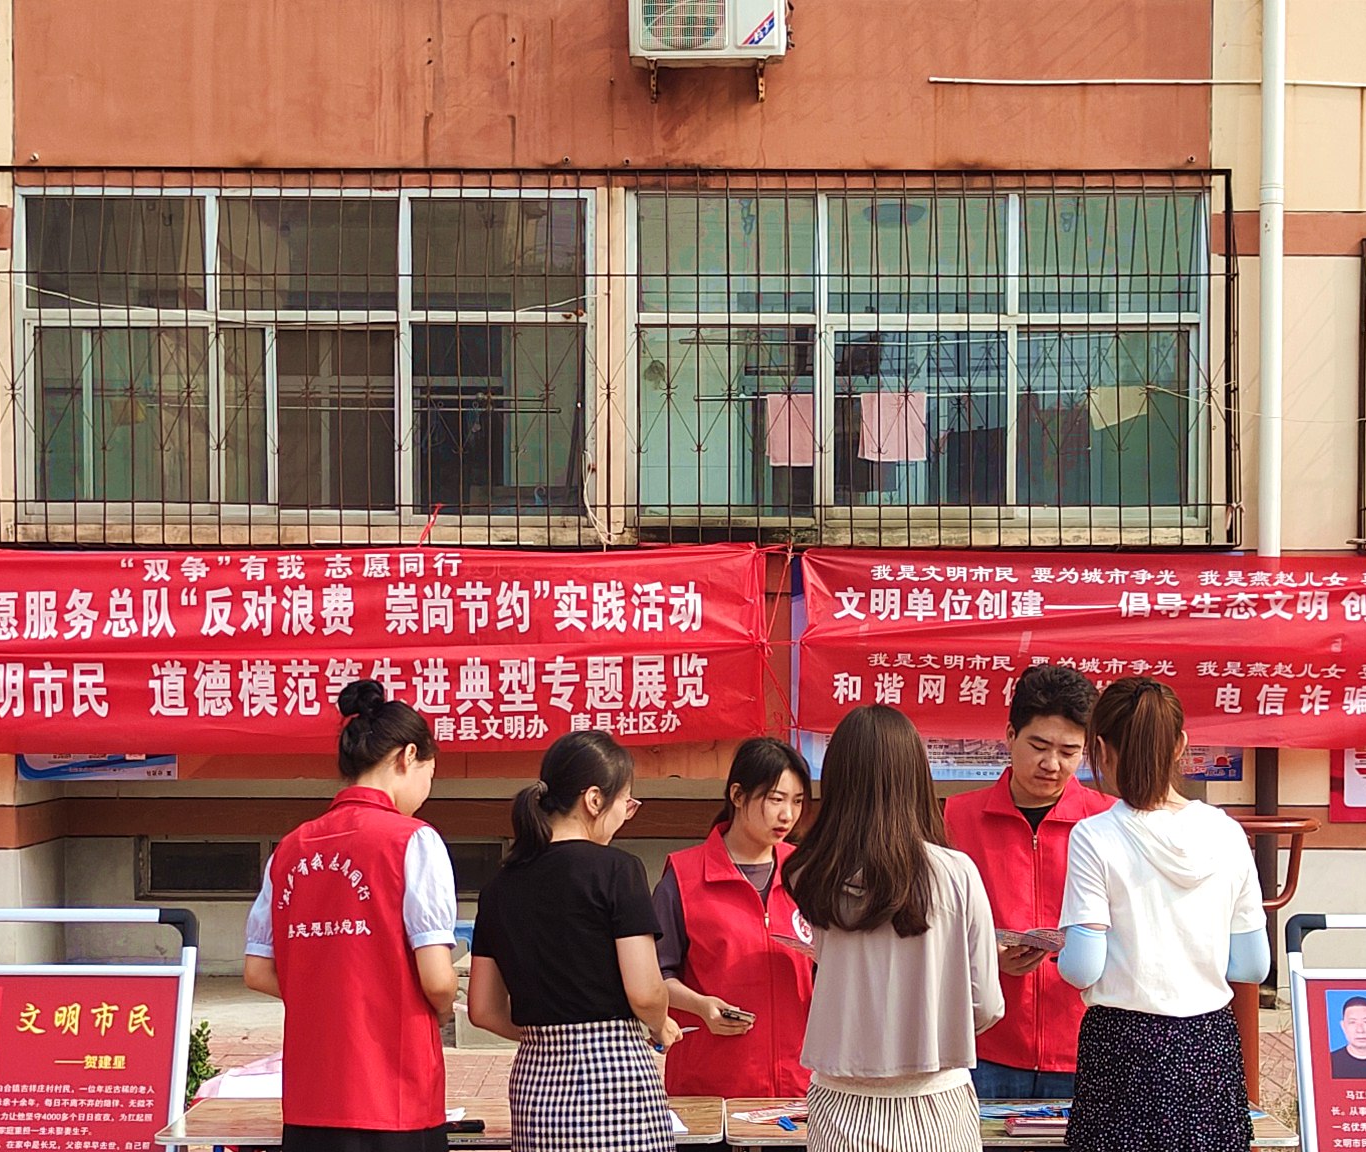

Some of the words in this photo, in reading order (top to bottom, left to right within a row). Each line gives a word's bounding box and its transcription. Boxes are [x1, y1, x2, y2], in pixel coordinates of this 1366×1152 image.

[120, 555, 304, 581] “双争”有我
[326, 552, 463, 578] 志愿同行
[871, 564, 1018, 583] 我是文明市民
[1031, 567, 1179, 587] 要为城市争光
[1198, 570, 1347, 588] 我是燕赵儿女
[385, 580, 702, 634] 崇尚节约”实践活动
[867, 652, 1015, 671] 我是文明市民
[1196, 661, 1346, 680] 我是燕赵儿女
[148, 653, 709, 717] 道德模范等先进典型专题展览
[435, 713, 548, 742] 唐县文明办
[571, 710, 681, 736] 唐县社区办
[16, 1002, 156, 1038] 文明市民
